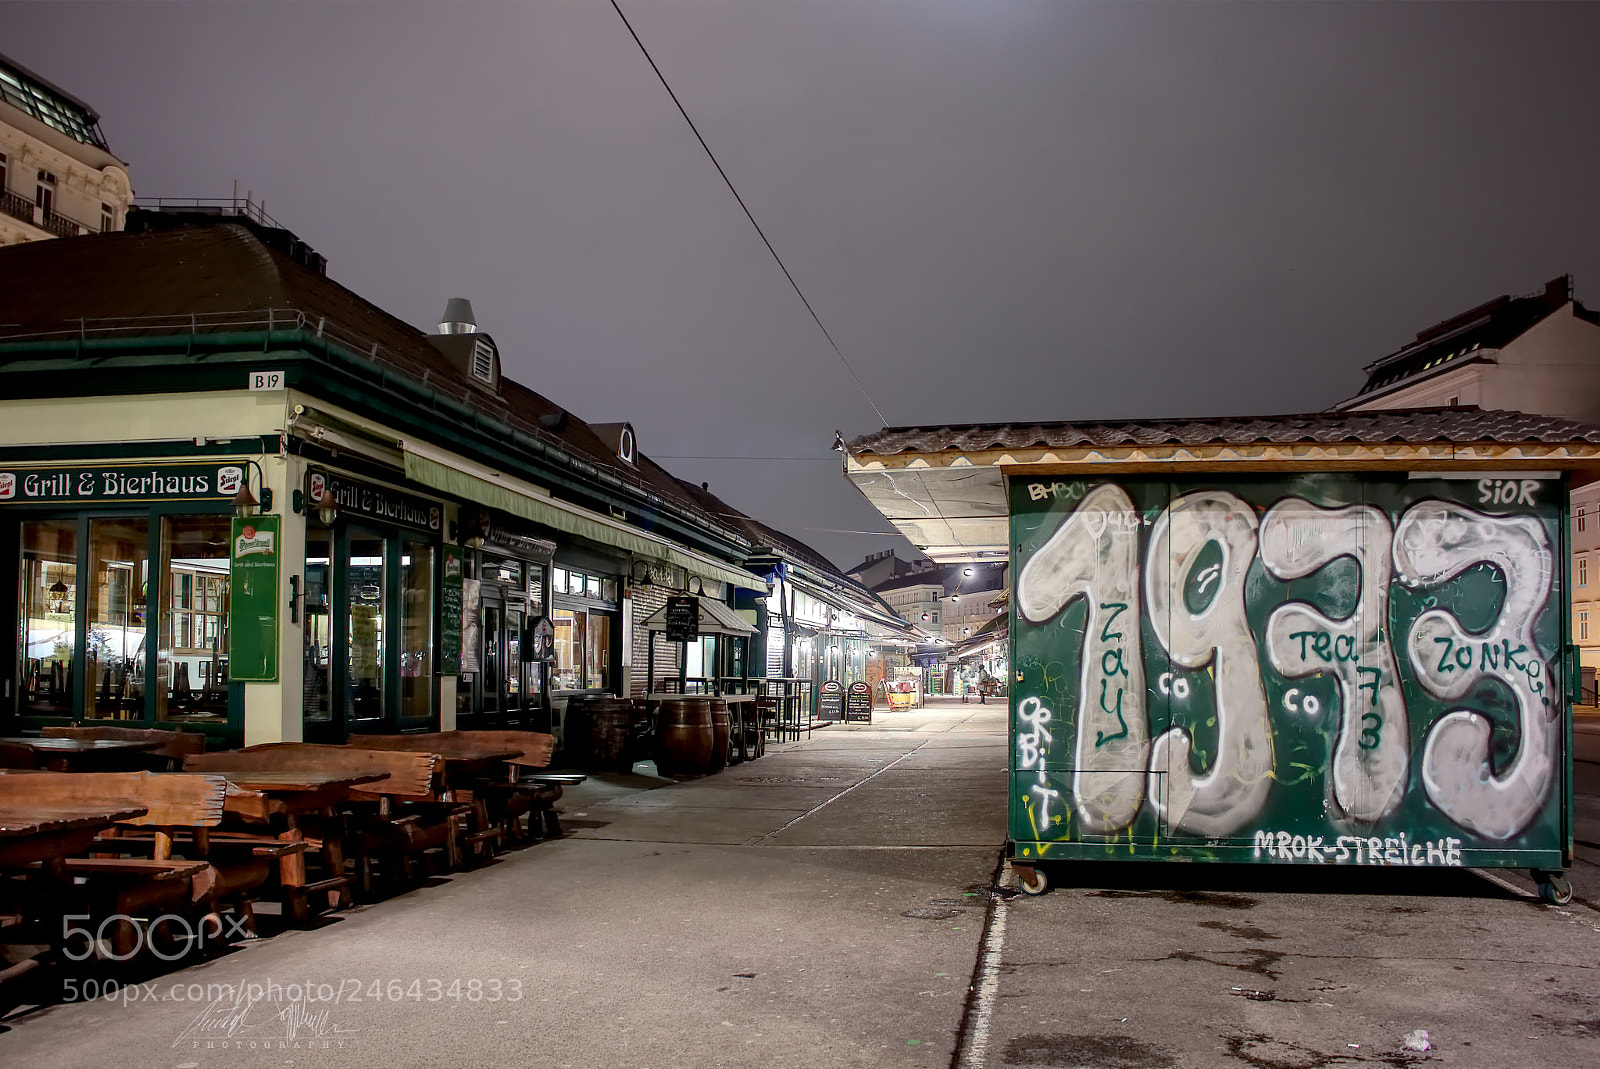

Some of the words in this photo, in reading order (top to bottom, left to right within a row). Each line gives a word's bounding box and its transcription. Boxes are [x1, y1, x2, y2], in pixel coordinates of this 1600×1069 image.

[255, 375, 264, 389] B
[267, 374, 279, 388] 19
[24, 472, 71, 497] Grill
[77, 472, 95, 496] &
[102, 471, 209, 495] Bierhaus
[330, 481, 358, 509] Grill
[362, 489, 372, 511] &
[375, 493, 427, 526] Bierhaus
[1017, 482, 1552, 840] 1973
